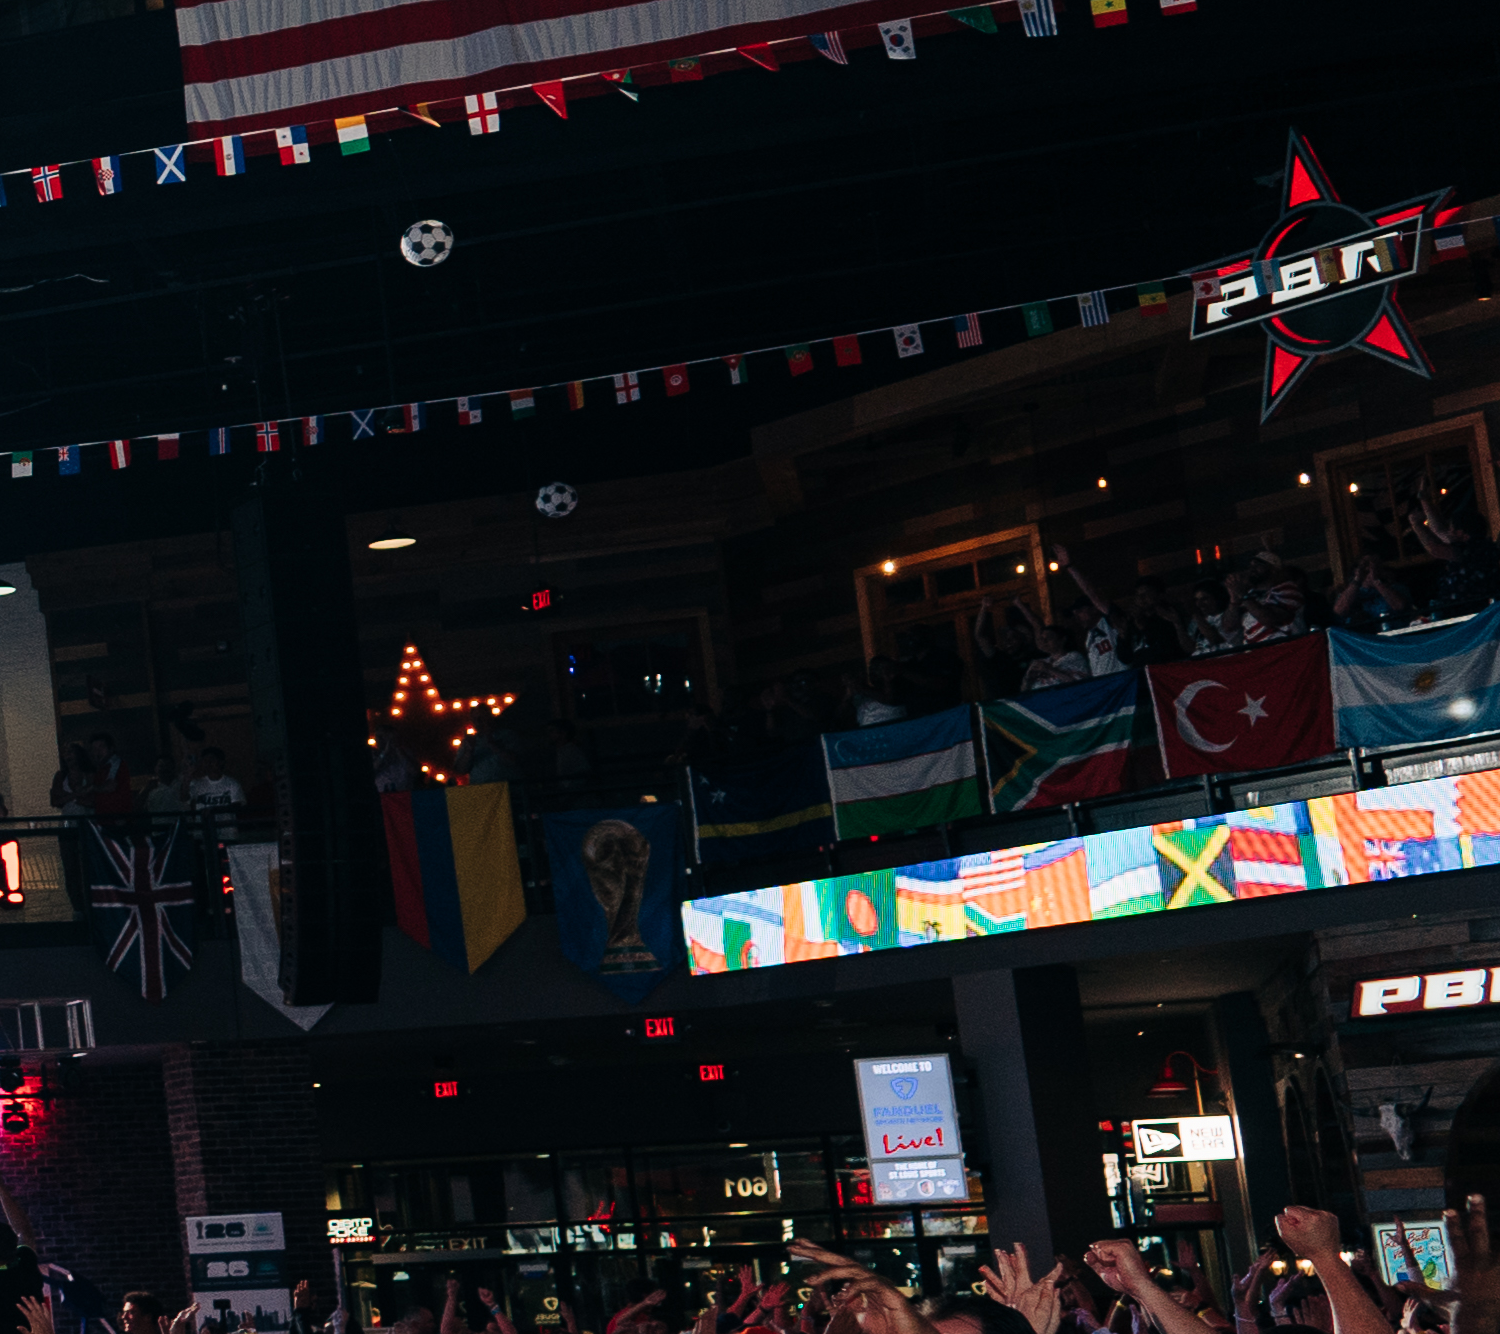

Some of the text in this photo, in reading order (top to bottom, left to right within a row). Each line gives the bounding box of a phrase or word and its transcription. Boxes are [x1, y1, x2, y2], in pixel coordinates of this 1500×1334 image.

[532, 589, 551, 611] EXIT
[1359, 967, 1500, 1016] PB
[645, 1018, 674, 1039] EXIT
[700, 1065, 724, 1082] EXIT
[872, 1061, 932, 1075] WELCOME TO
[435, 1081, 459, 1097] EXIT
[873, 1103, 943, 1117] FANDUEL
[883, 1127, 944, 1154] Live!
[448, 1237, 487, 1250] EXIT
